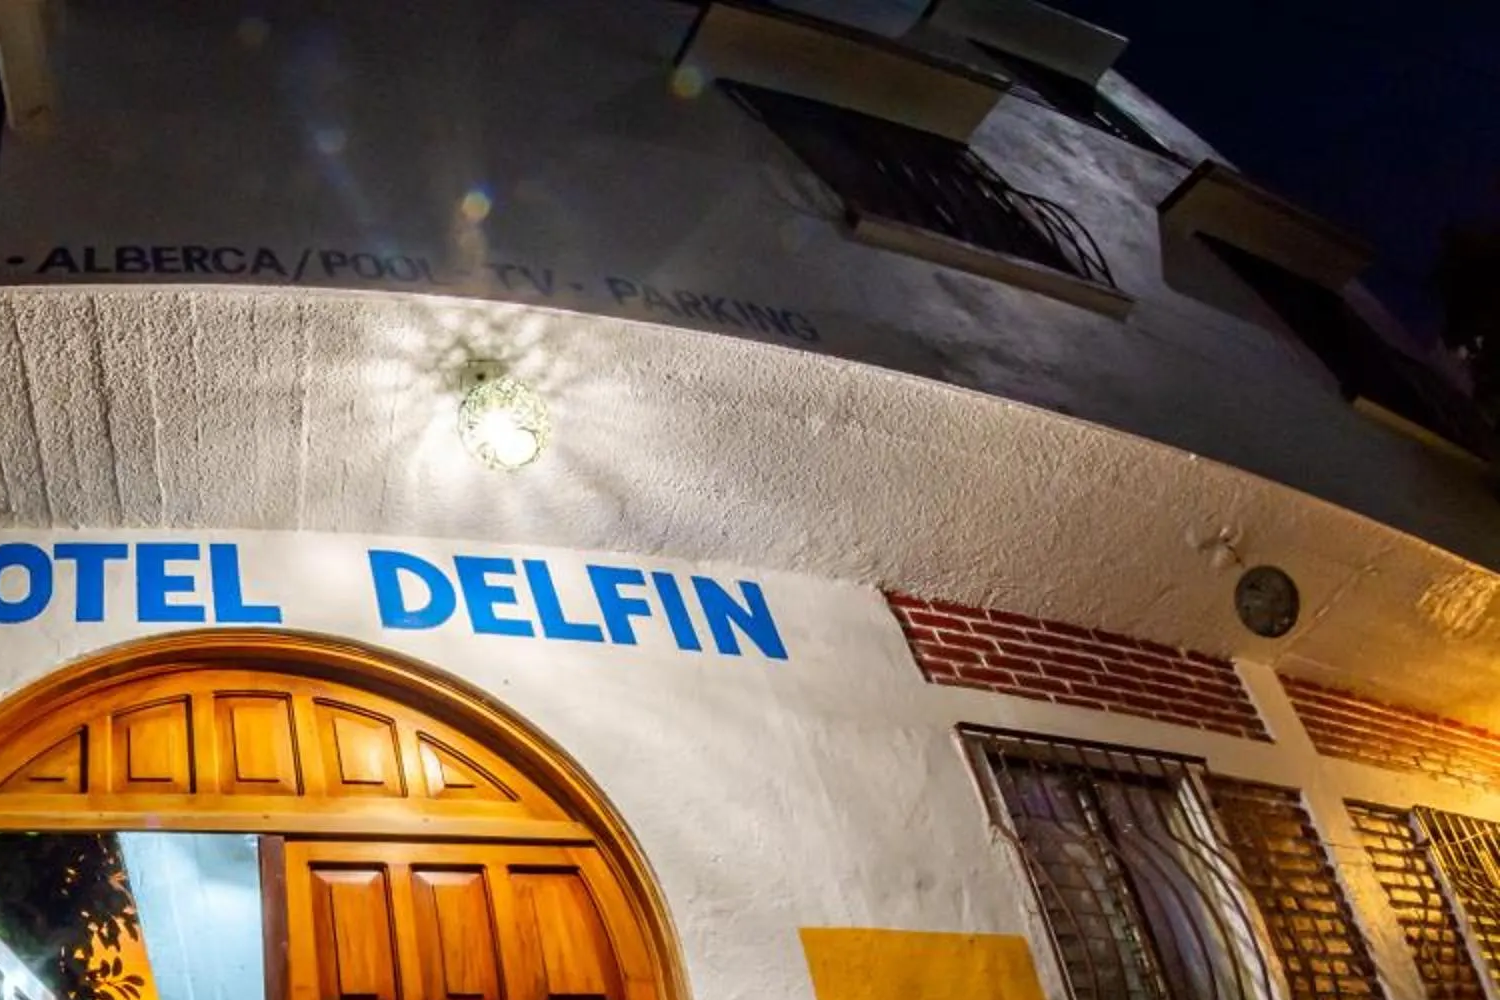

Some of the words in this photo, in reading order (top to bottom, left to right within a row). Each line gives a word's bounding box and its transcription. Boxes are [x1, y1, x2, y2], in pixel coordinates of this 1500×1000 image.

[487, 261, 555, 297] TV
[603, 274, 820, 342] PARKING
[369, 550, 787, 659] DELFIN
